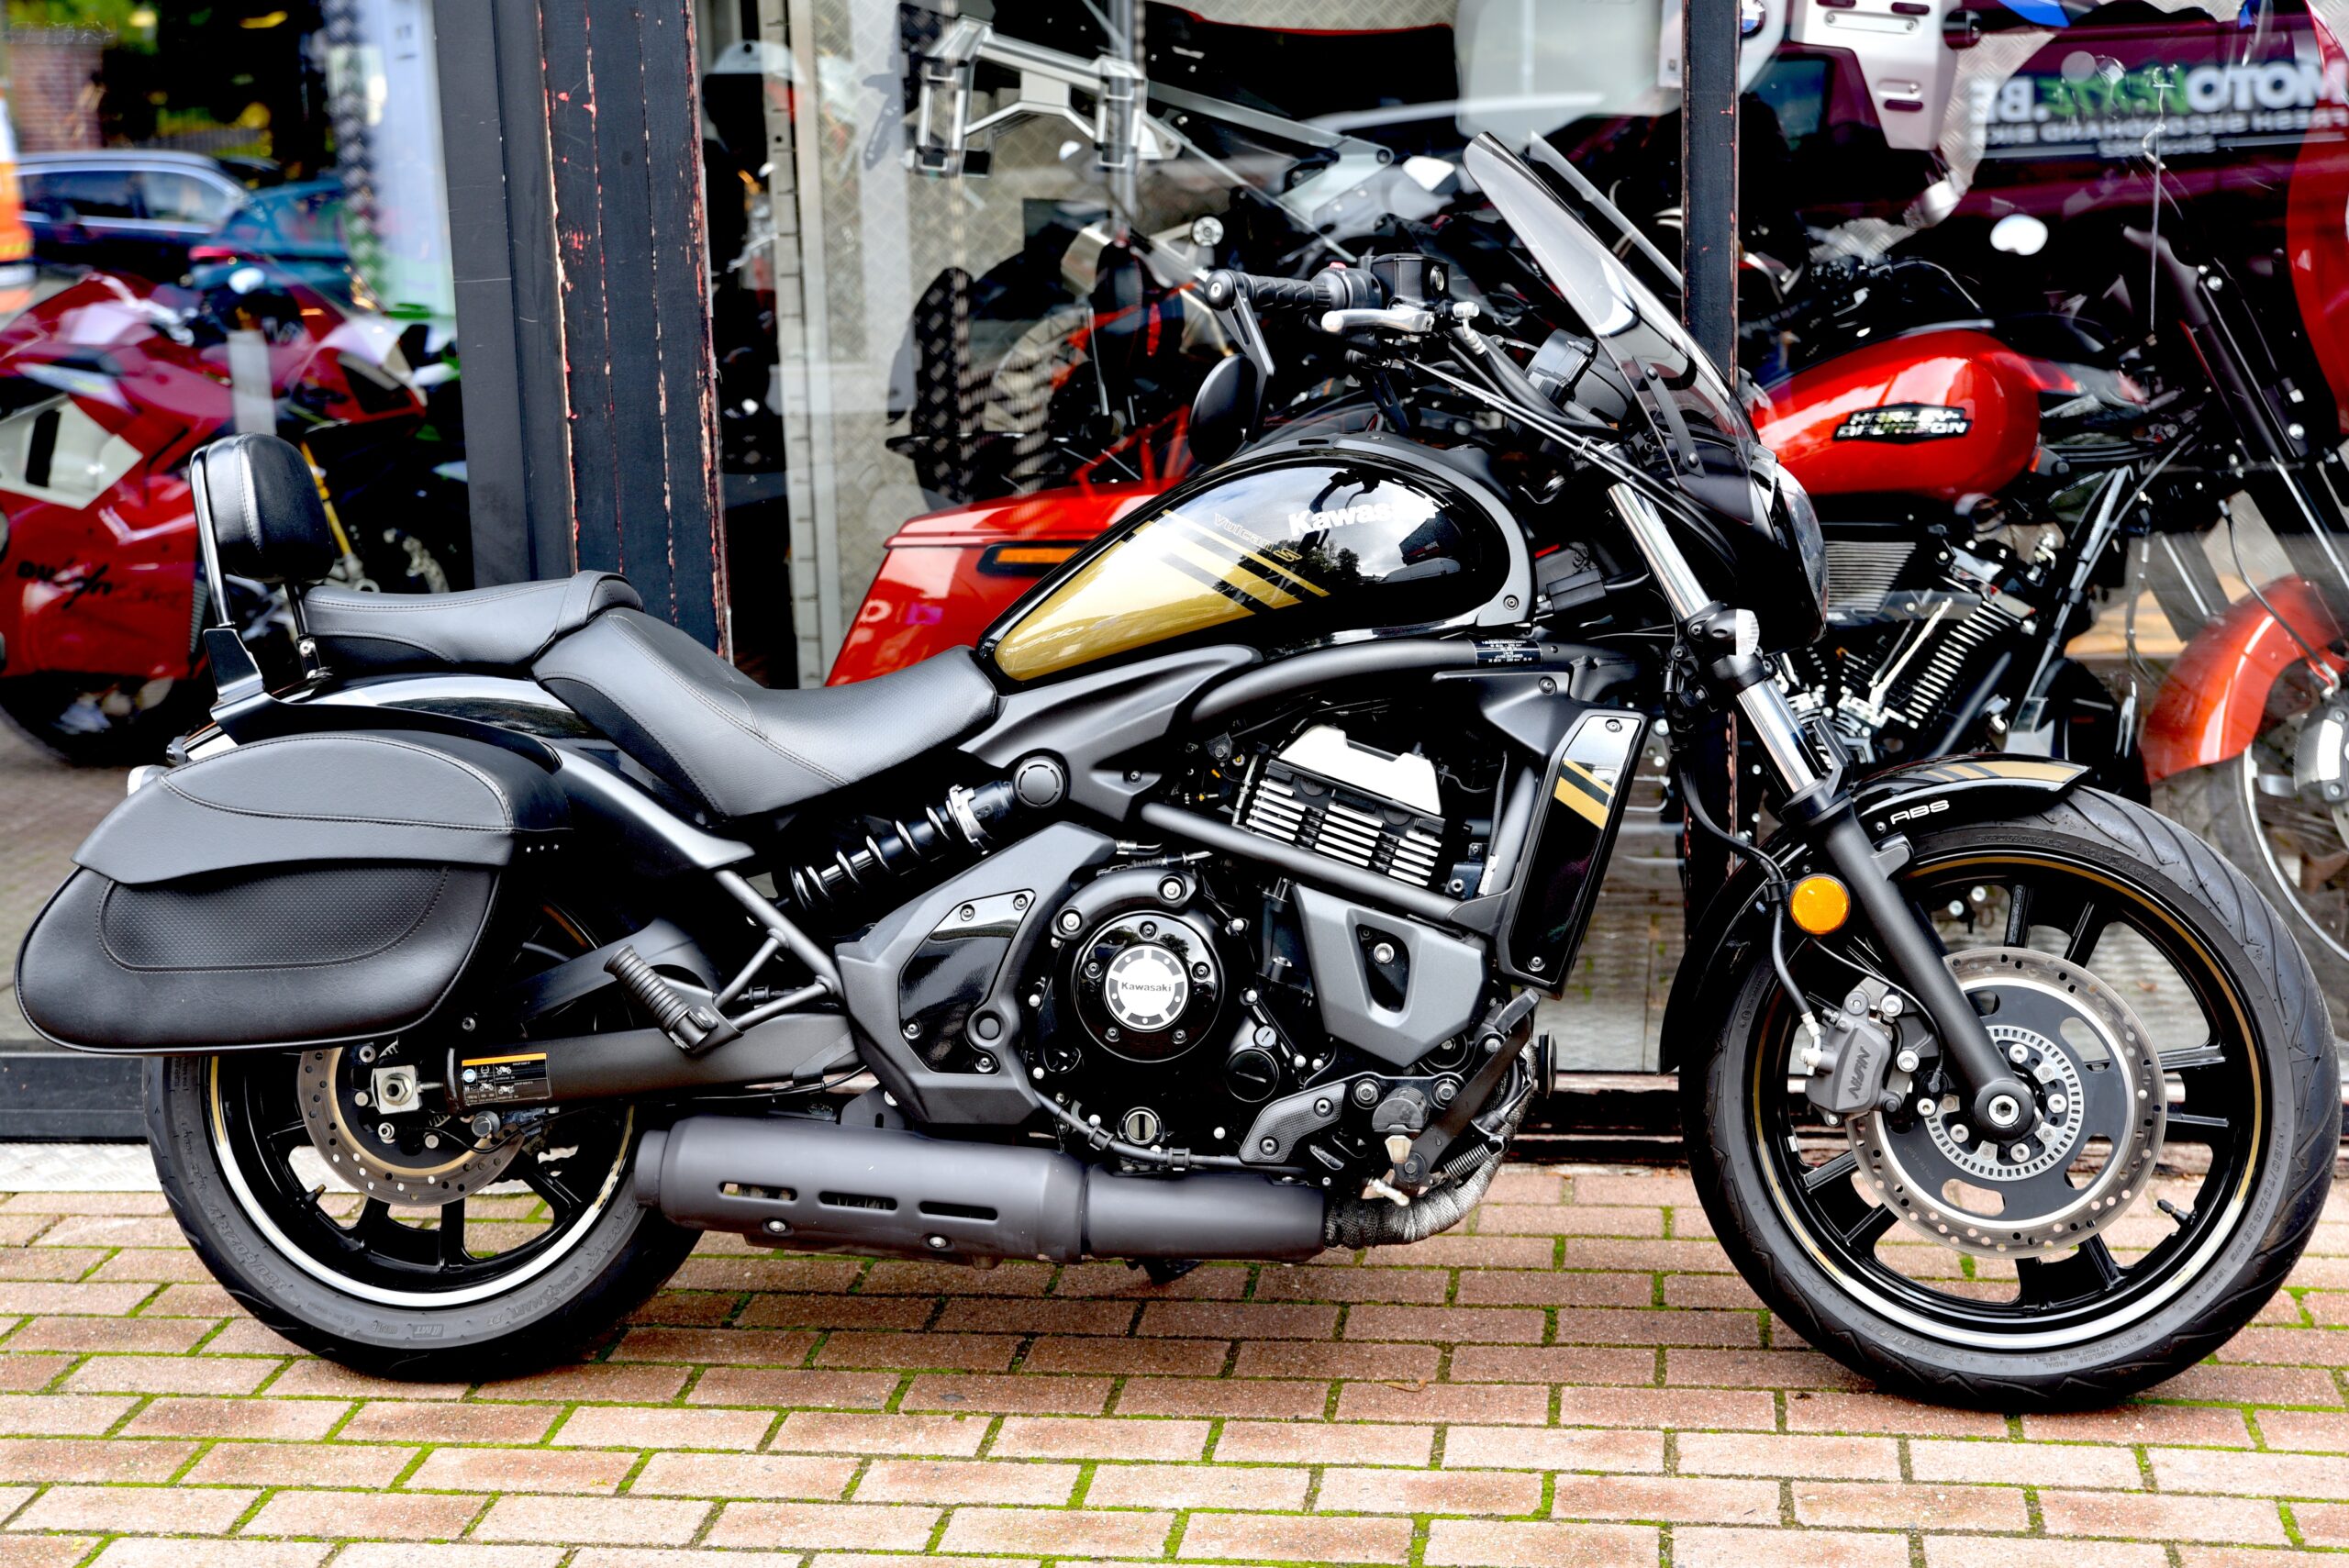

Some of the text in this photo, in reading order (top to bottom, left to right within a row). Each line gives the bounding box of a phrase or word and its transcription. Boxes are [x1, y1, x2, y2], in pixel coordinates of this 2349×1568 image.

[1273, 548, 1303, 562] S
[1889, 799, 1950, 825] ABS
[1121, 982, 1172, 992] Kawasaki
